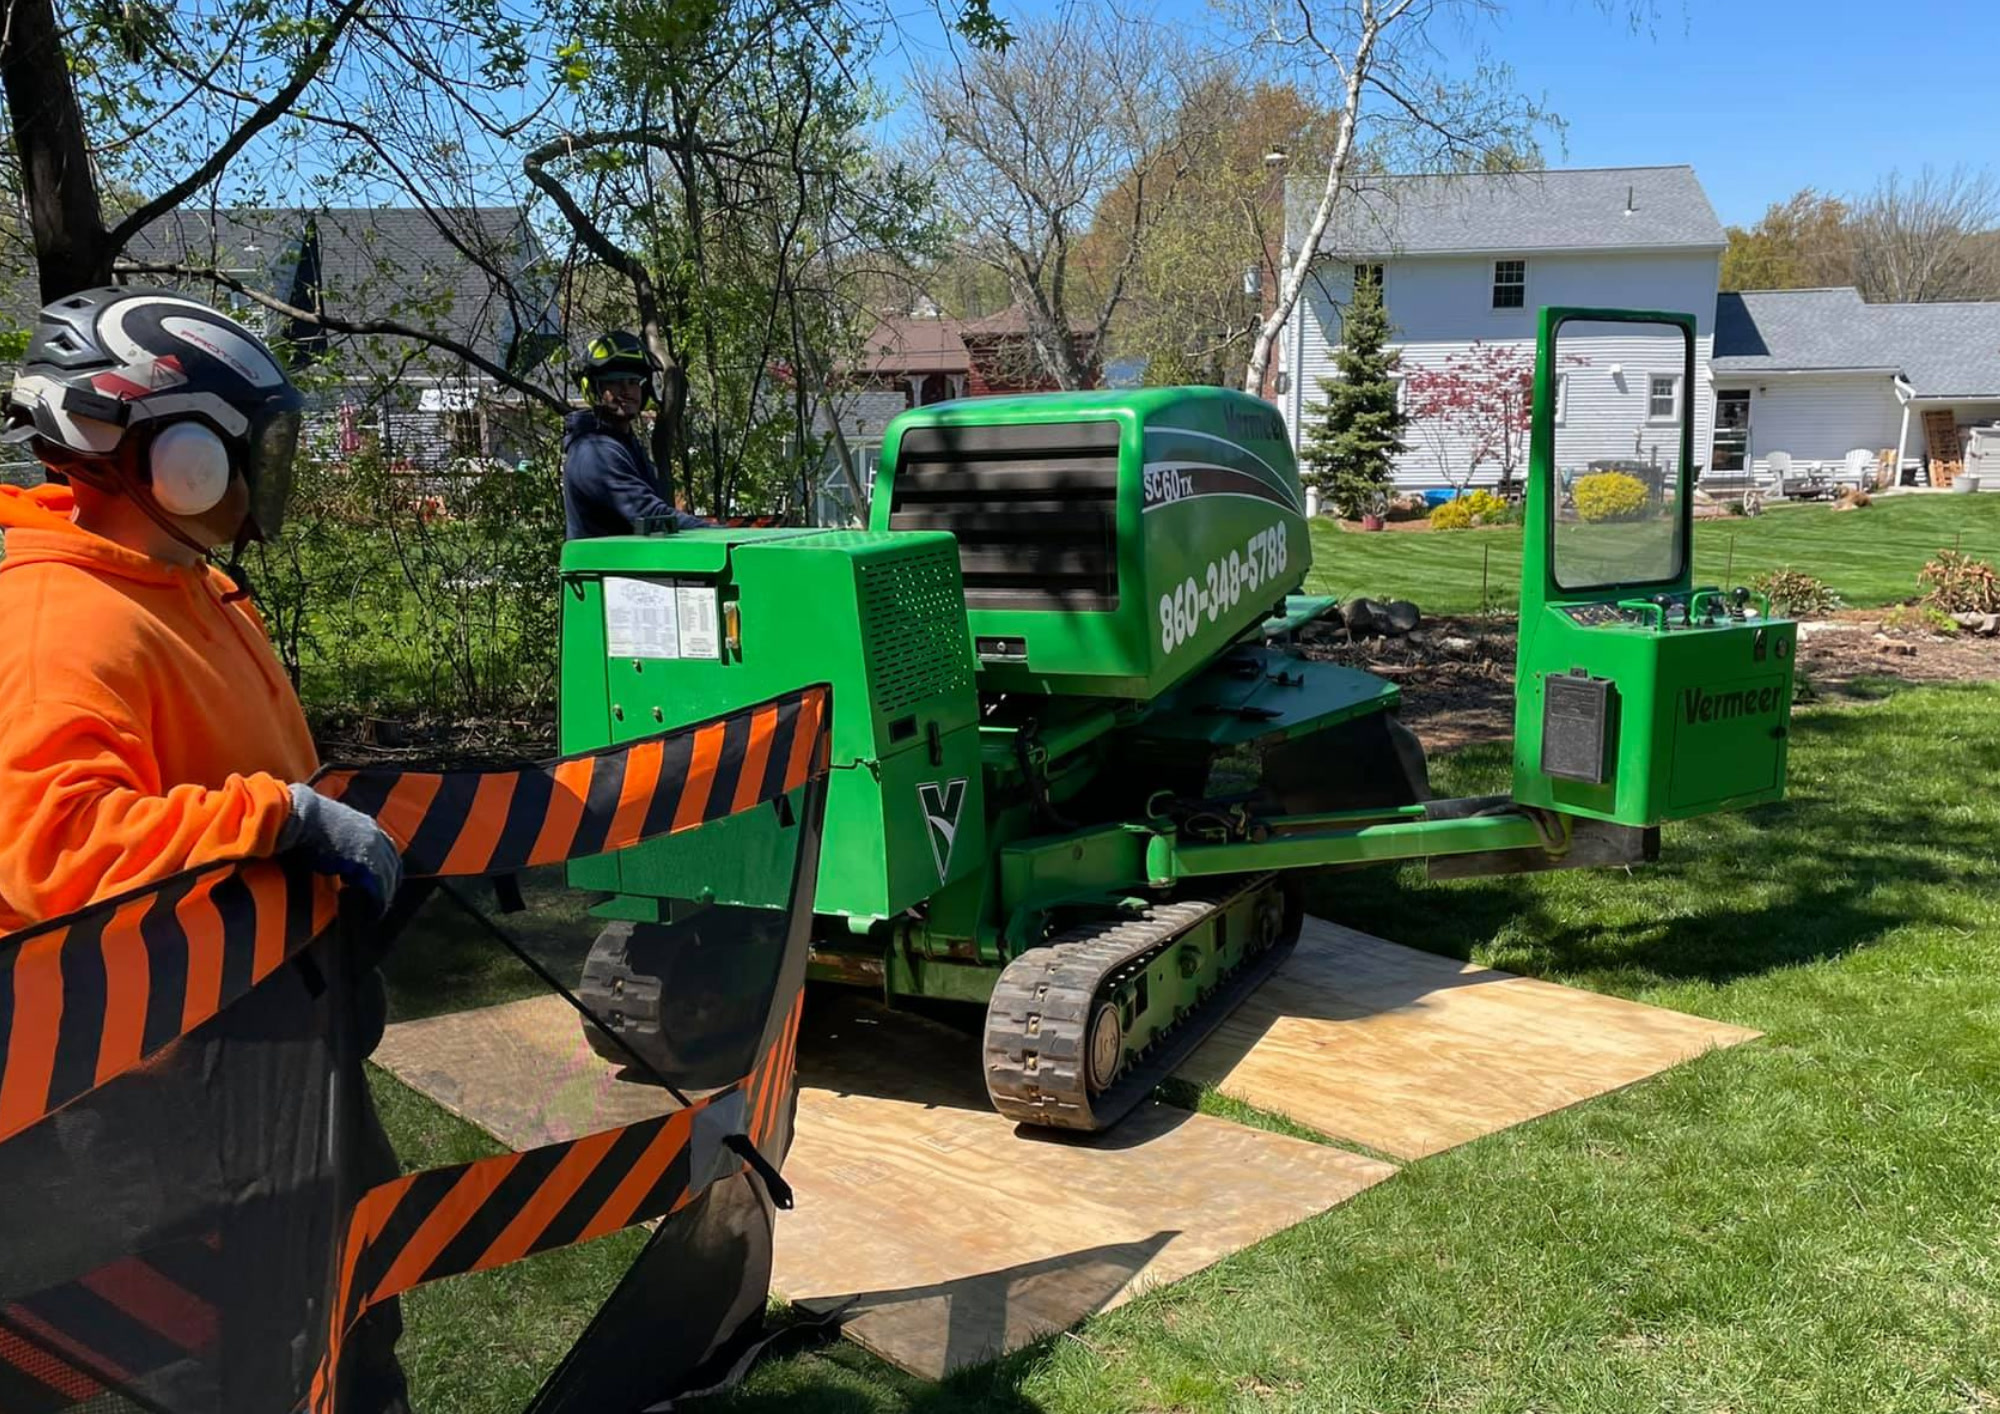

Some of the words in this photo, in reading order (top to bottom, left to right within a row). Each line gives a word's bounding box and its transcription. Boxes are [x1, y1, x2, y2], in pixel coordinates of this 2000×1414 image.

[1144, 469, 1194, 502] SC60TX
[1160, 520, 1287, 654] 860-348-5788
[1684, 687, 1782, 725] Vermeer
